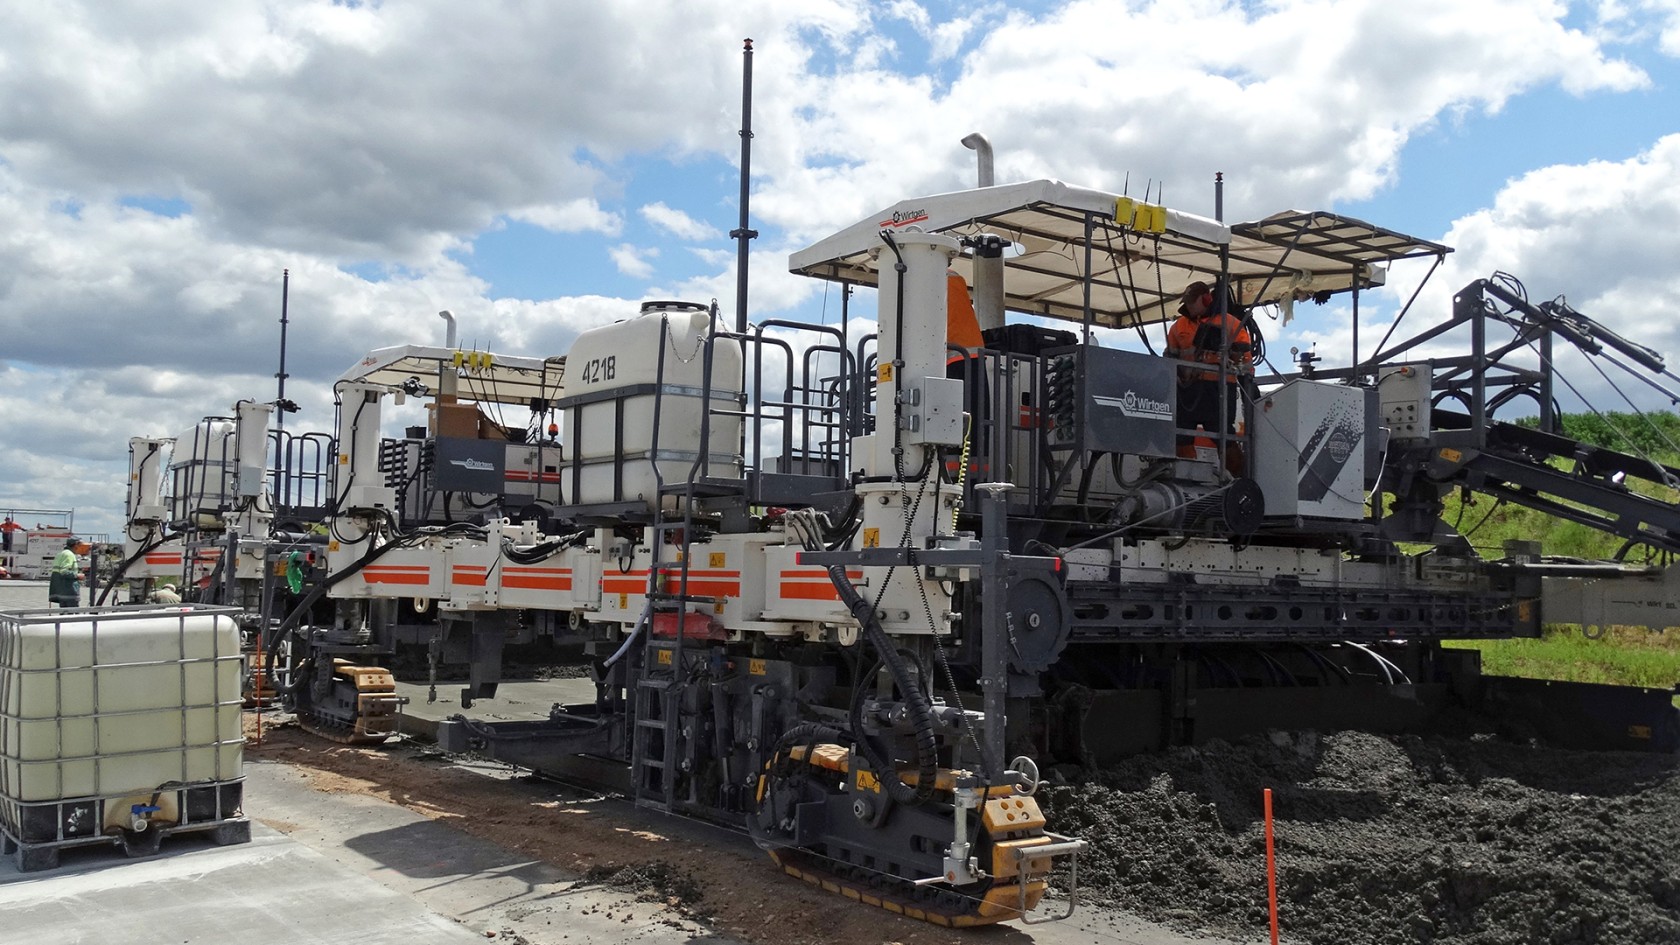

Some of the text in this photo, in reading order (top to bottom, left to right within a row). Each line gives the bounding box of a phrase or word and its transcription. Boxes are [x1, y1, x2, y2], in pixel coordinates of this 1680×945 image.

[900, 209, 925, 220] Wirtgen
[582, 355, 616, 384] 4218
[1137, 397, 1170, 413] Wirtgen
